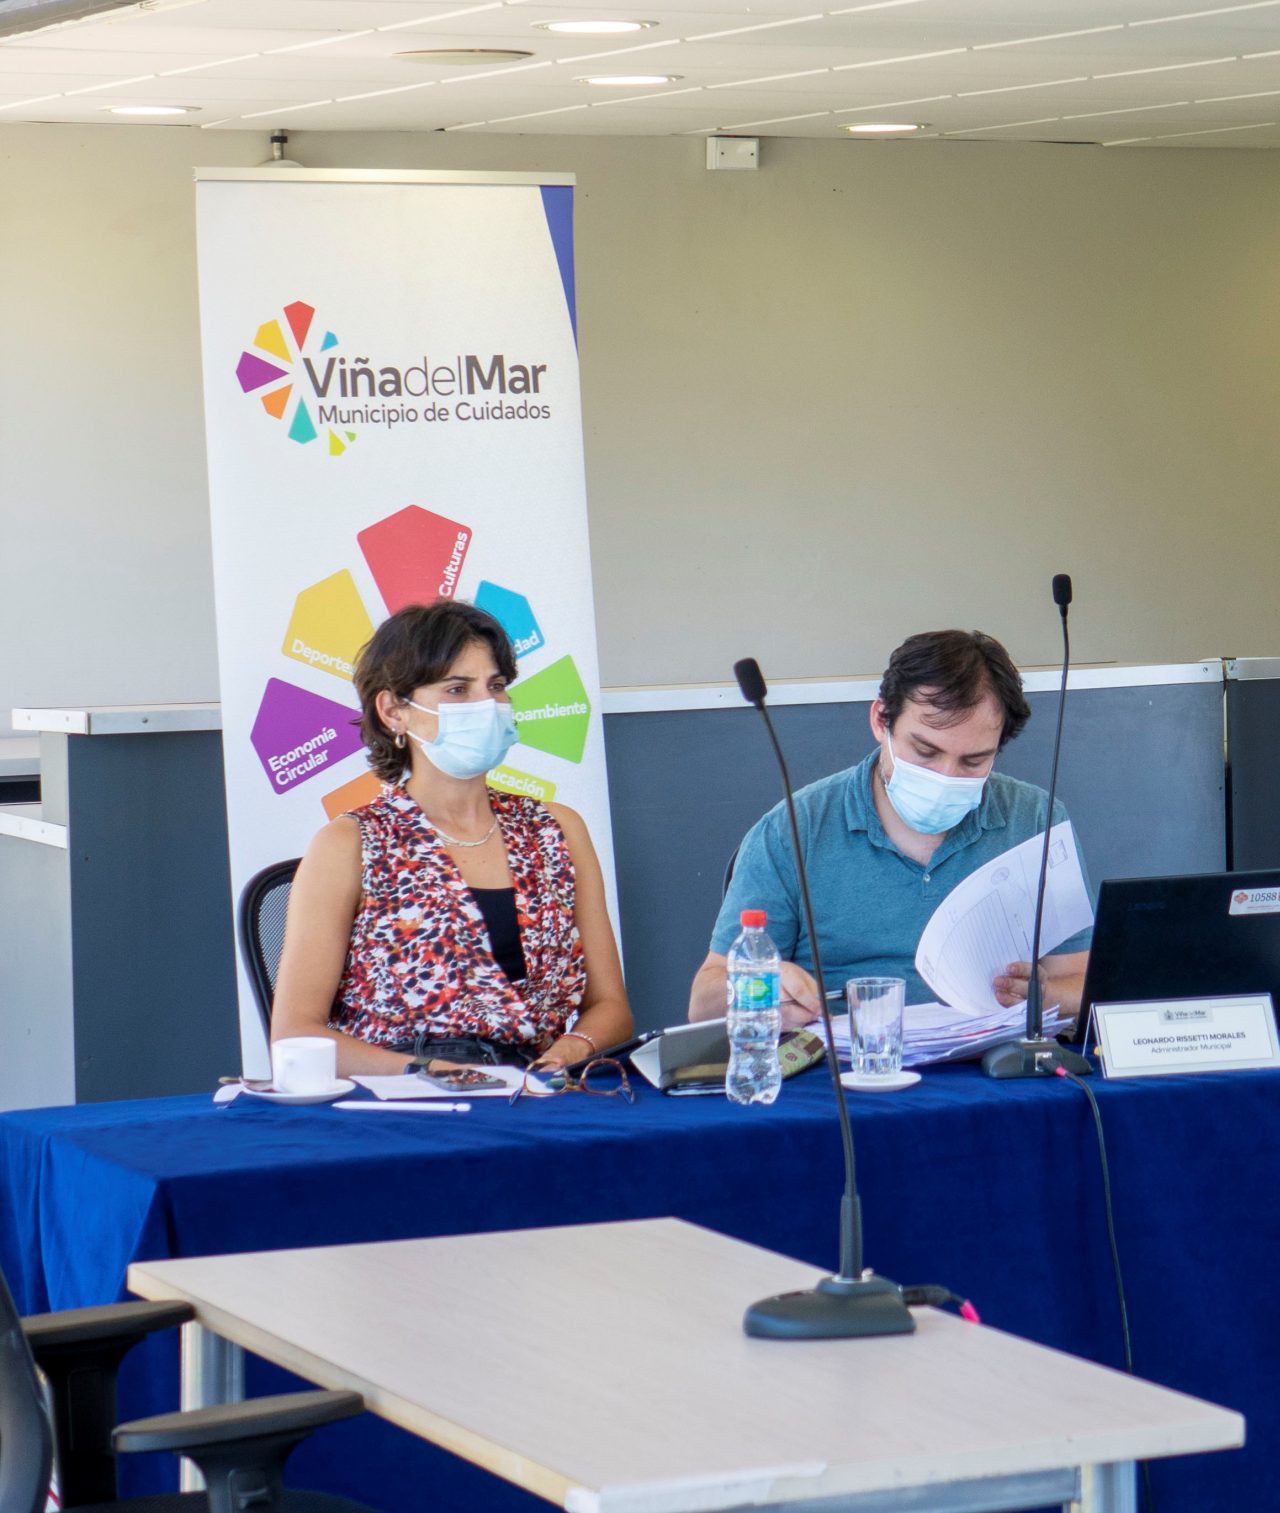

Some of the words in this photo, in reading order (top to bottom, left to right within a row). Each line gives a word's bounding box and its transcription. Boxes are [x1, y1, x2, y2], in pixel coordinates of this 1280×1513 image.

[318, 403, 419, 429] Municipio
[423, 402, 450, 423] de
[455, 400, 551, 422] Cuidados
[438, 531, 468, 598] Culturas
[267, 726, 338, 771] Economía
[275, 749, 330, 786] Circular
[1250, 892, 1277, 902] 10588
[1133, 1036, 1175, 1046] LEONARDO
[1209, 1031, 1246, 1041] MORALES
[1151, 1044, 1199, 1054] Administrador
[1200, 1041, 1232, 1052] Municipal
